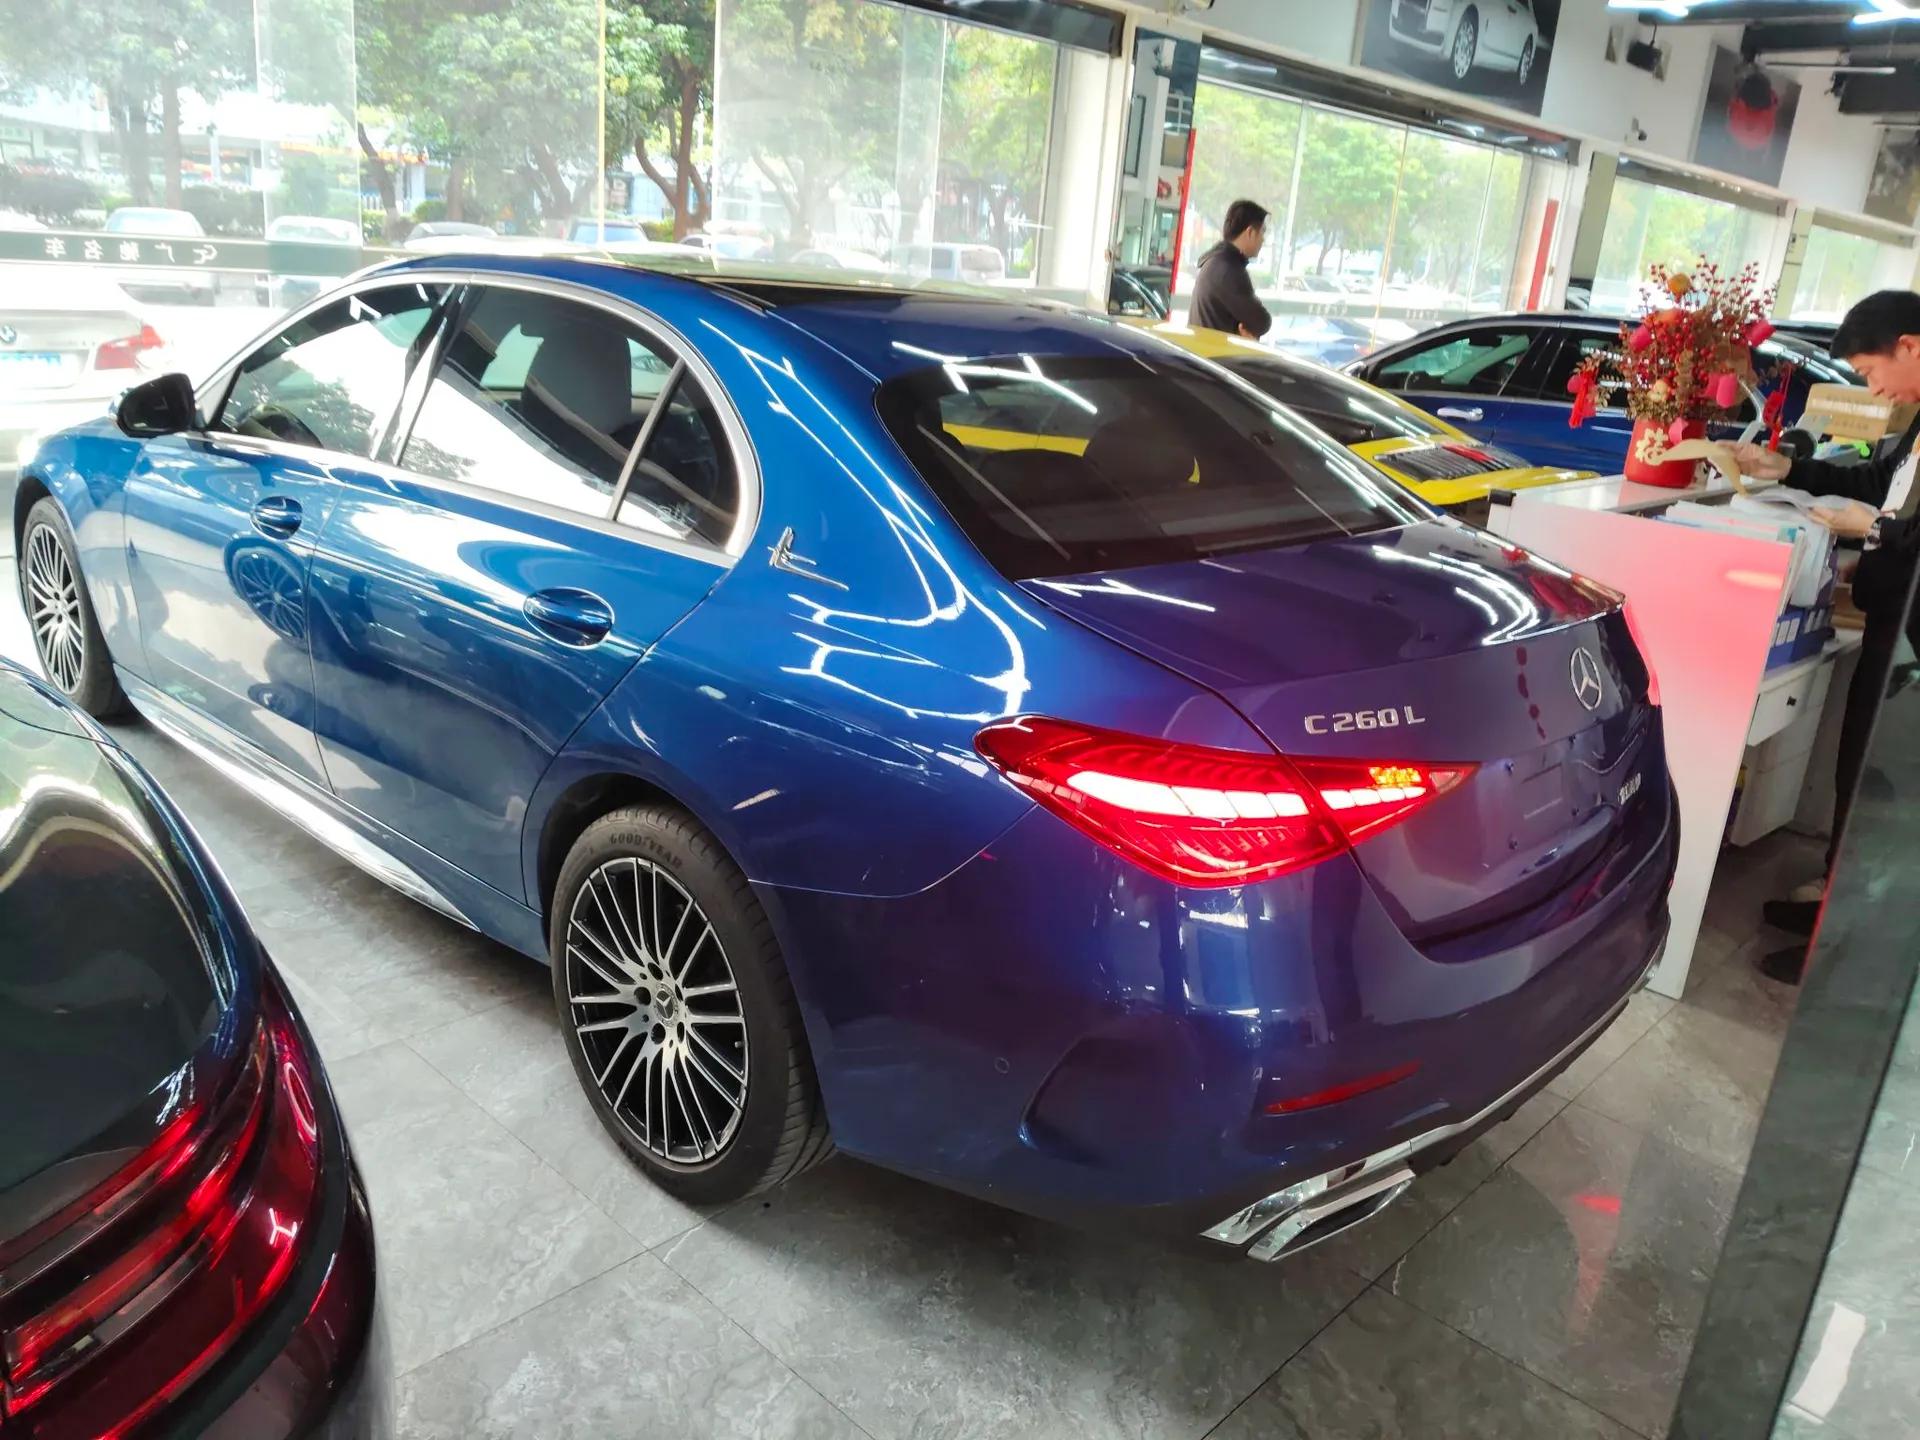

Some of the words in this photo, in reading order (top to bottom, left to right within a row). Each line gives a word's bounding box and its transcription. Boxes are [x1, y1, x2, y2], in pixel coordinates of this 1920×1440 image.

[1305, 714, 1328, 734] C
[1333, 708, 1399, 733] 260
[1404, 705, 1425, 725] L
[610, 833, 683, 868] GOODYEAR
